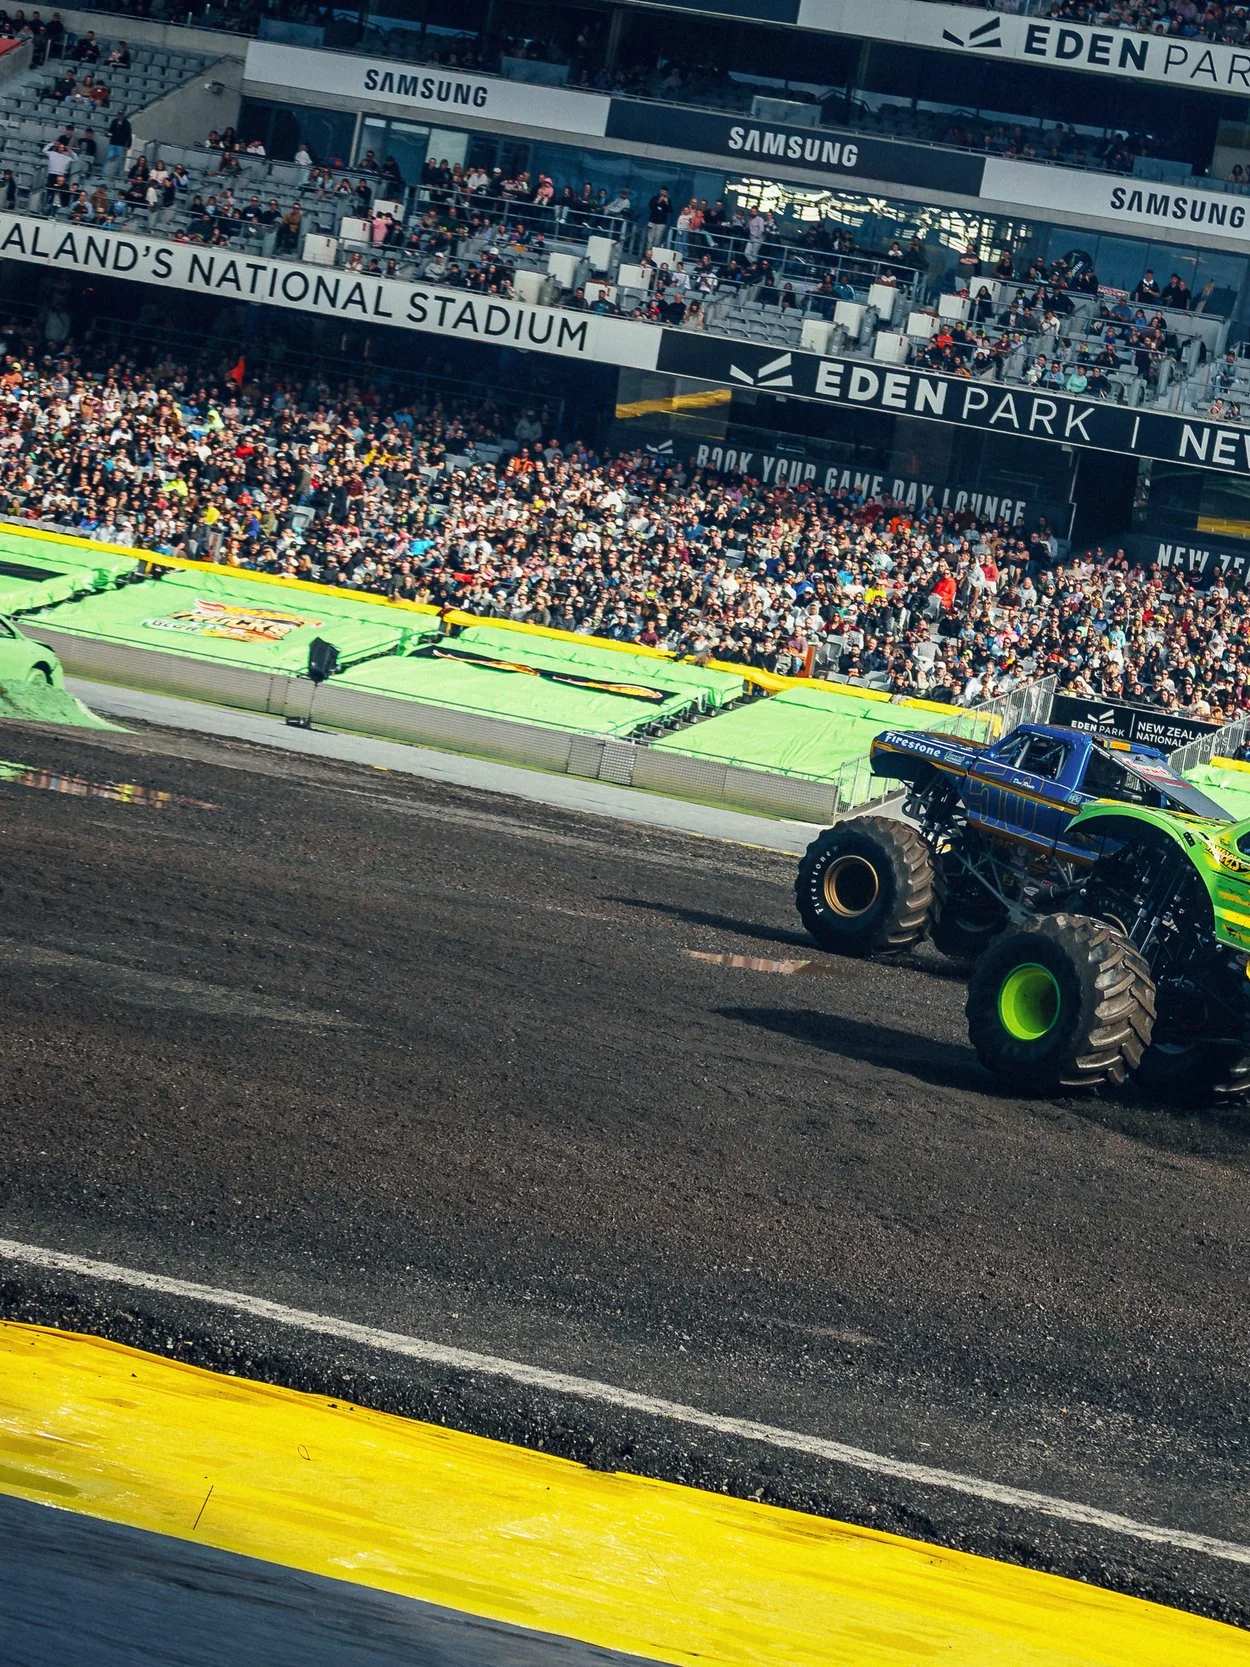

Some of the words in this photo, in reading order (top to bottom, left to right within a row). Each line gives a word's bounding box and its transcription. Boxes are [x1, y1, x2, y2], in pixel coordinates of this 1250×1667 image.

[1024, 24, 1149, 71] EDEN
[364, 68, 488, 108] SAMSUNG
[729, 126, 858, 167] SAMSUNG
[1110, 187, 1247, 230] SAMSUNG
[0, 222, 174, 279] ALAND'S
[188, 254, 394, 319] NATIONAL
[407, 292, 590, 352] STADIUM
[815, 361, 949, 415] EDEN
[962, 385, 1099, 442] PARK
[825, 467, 884, 500] GAME
[893, 479, 935, 508] DAY
[1157, 543, 1209, 573] NEW
[884, 732, 941, 758] Firestone
[1071, 720, 1097, 732] EDEN
[1099, 725, 1125, 737] PARK
[1136, 732, 1183, 748] NATIONAL
[1137, 721, 1166, 734] NEW
